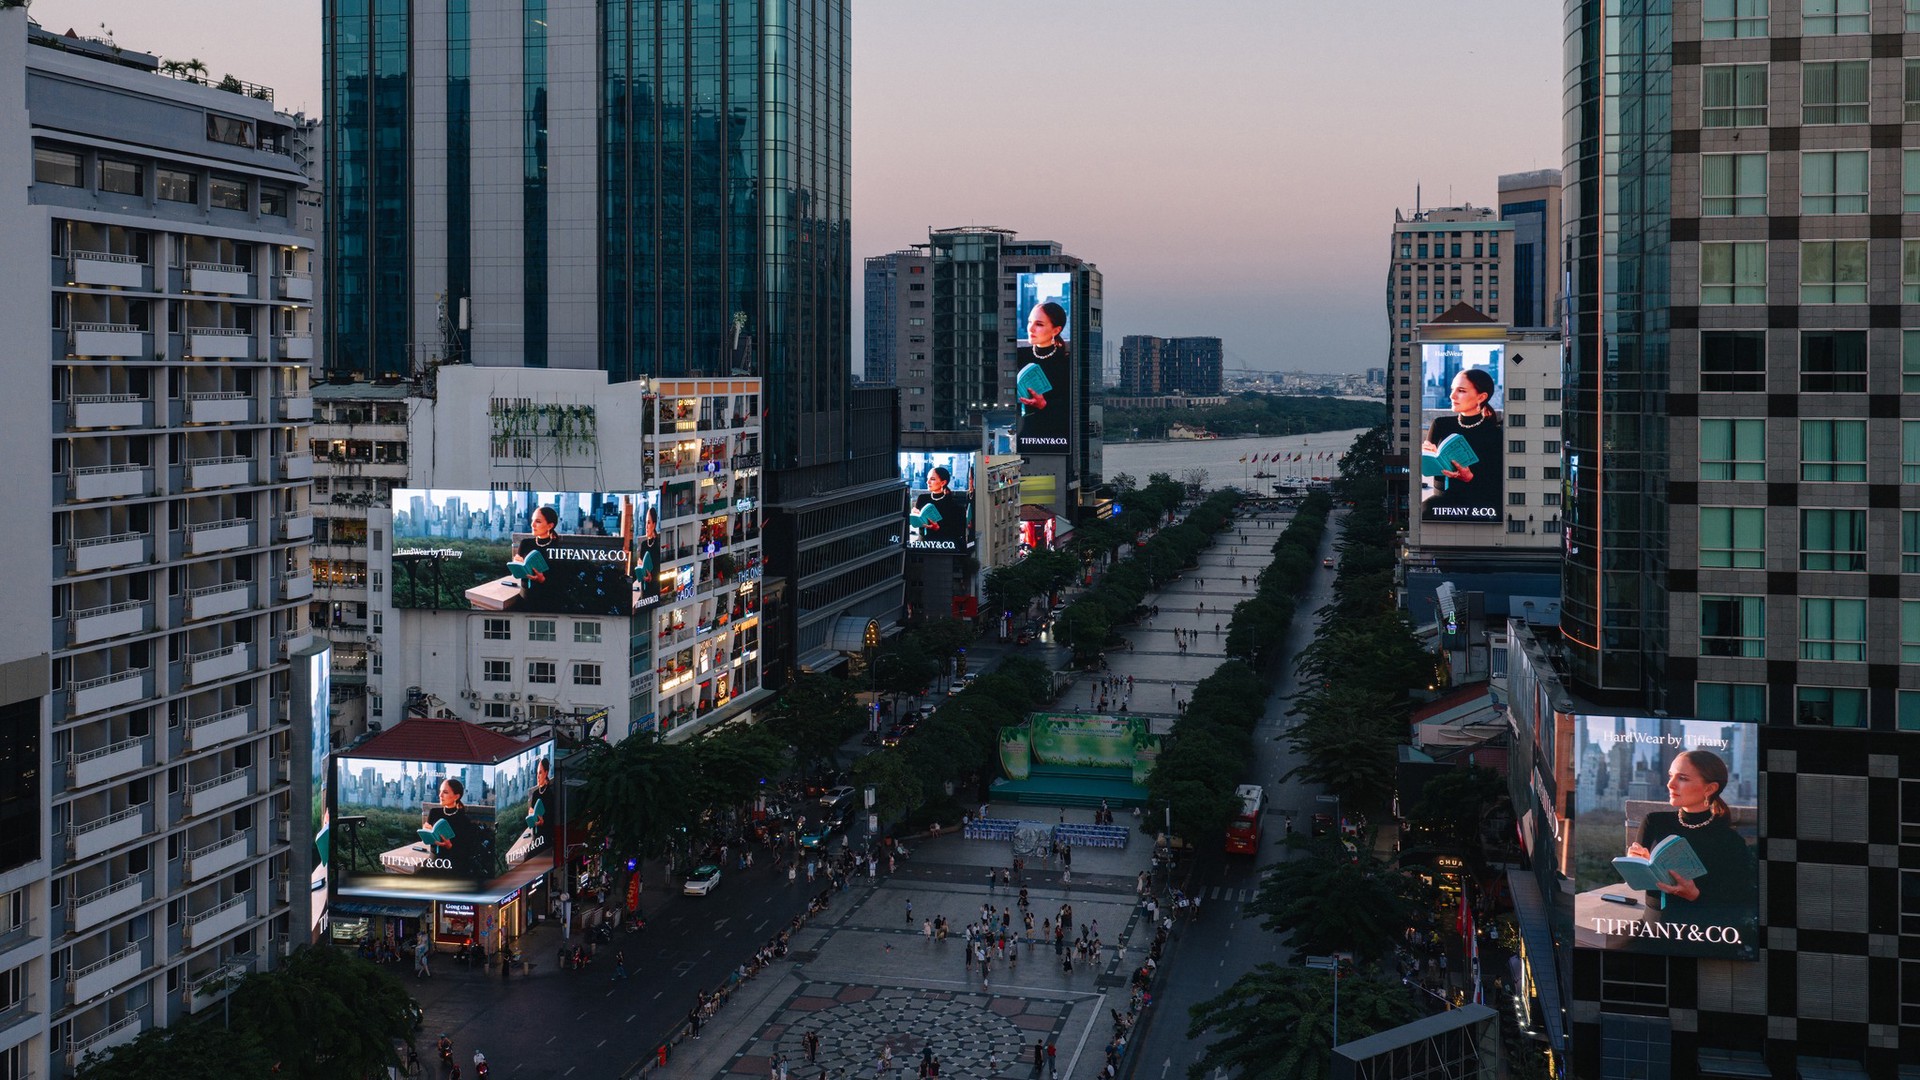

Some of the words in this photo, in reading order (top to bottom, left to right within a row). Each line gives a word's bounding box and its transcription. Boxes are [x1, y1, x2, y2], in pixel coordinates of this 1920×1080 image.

[1020, 437, 1068, 445] TIFFANY&CO.
[1432, 507, 1470, 516] TIFFANY
[1471, 507, 1497, 517] &CO.
[397, 547, 430, 556] HardWear
[430, 548, 439, 559] by
[440, 548, 463, 559] Tiffany
[546, 547, 628, 561] TIFFANY&CO.
[1603, 731, 1665, 745] HardWear
[1667, 733, 1682, 748] by
[1686, 734, 1729, 750] Tiffany
[380, 855, 453, 869] TIFFANY&CO.
[1591, 917, 1743, 945] TIFFANY&CO.
